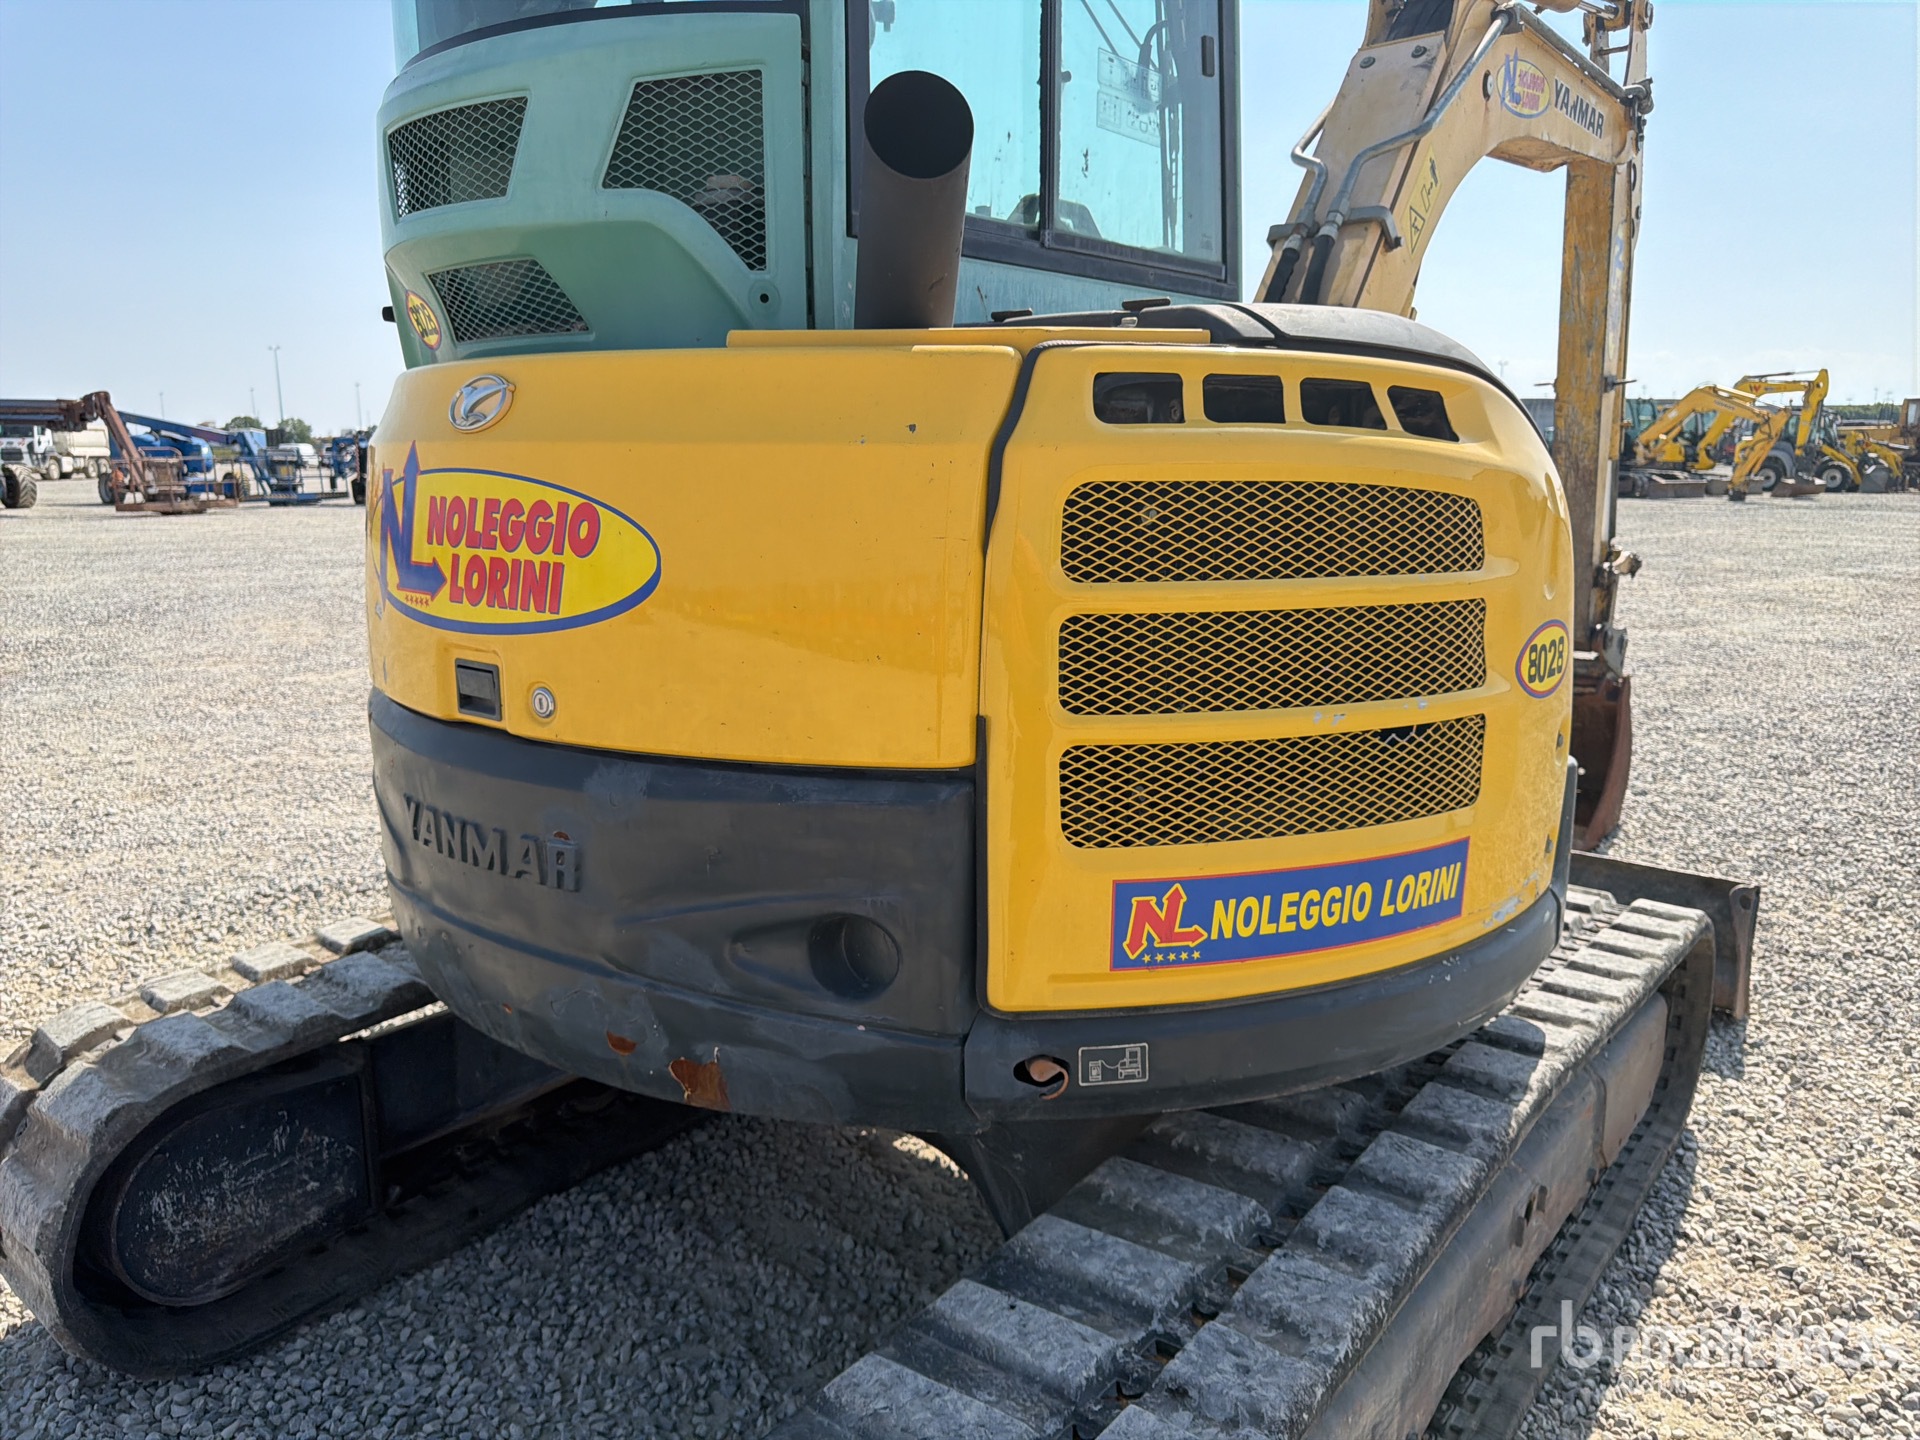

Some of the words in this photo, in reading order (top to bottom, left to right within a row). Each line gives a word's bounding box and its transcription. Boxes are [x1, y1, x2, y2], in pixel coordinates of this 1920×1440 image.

[1554, 77, 1605, 139] YANMAR
[427, 495, 601, 558] NOLEGGIO
[449, 553, 565, 614] LORINI
[1528, 635, 1564, 684] 8028
[403, 793, 582, 893] YANMAR
[1210, 881, 1372, 940] NOLEGGIO
[1380, 861, 1462, 917] LORINI
